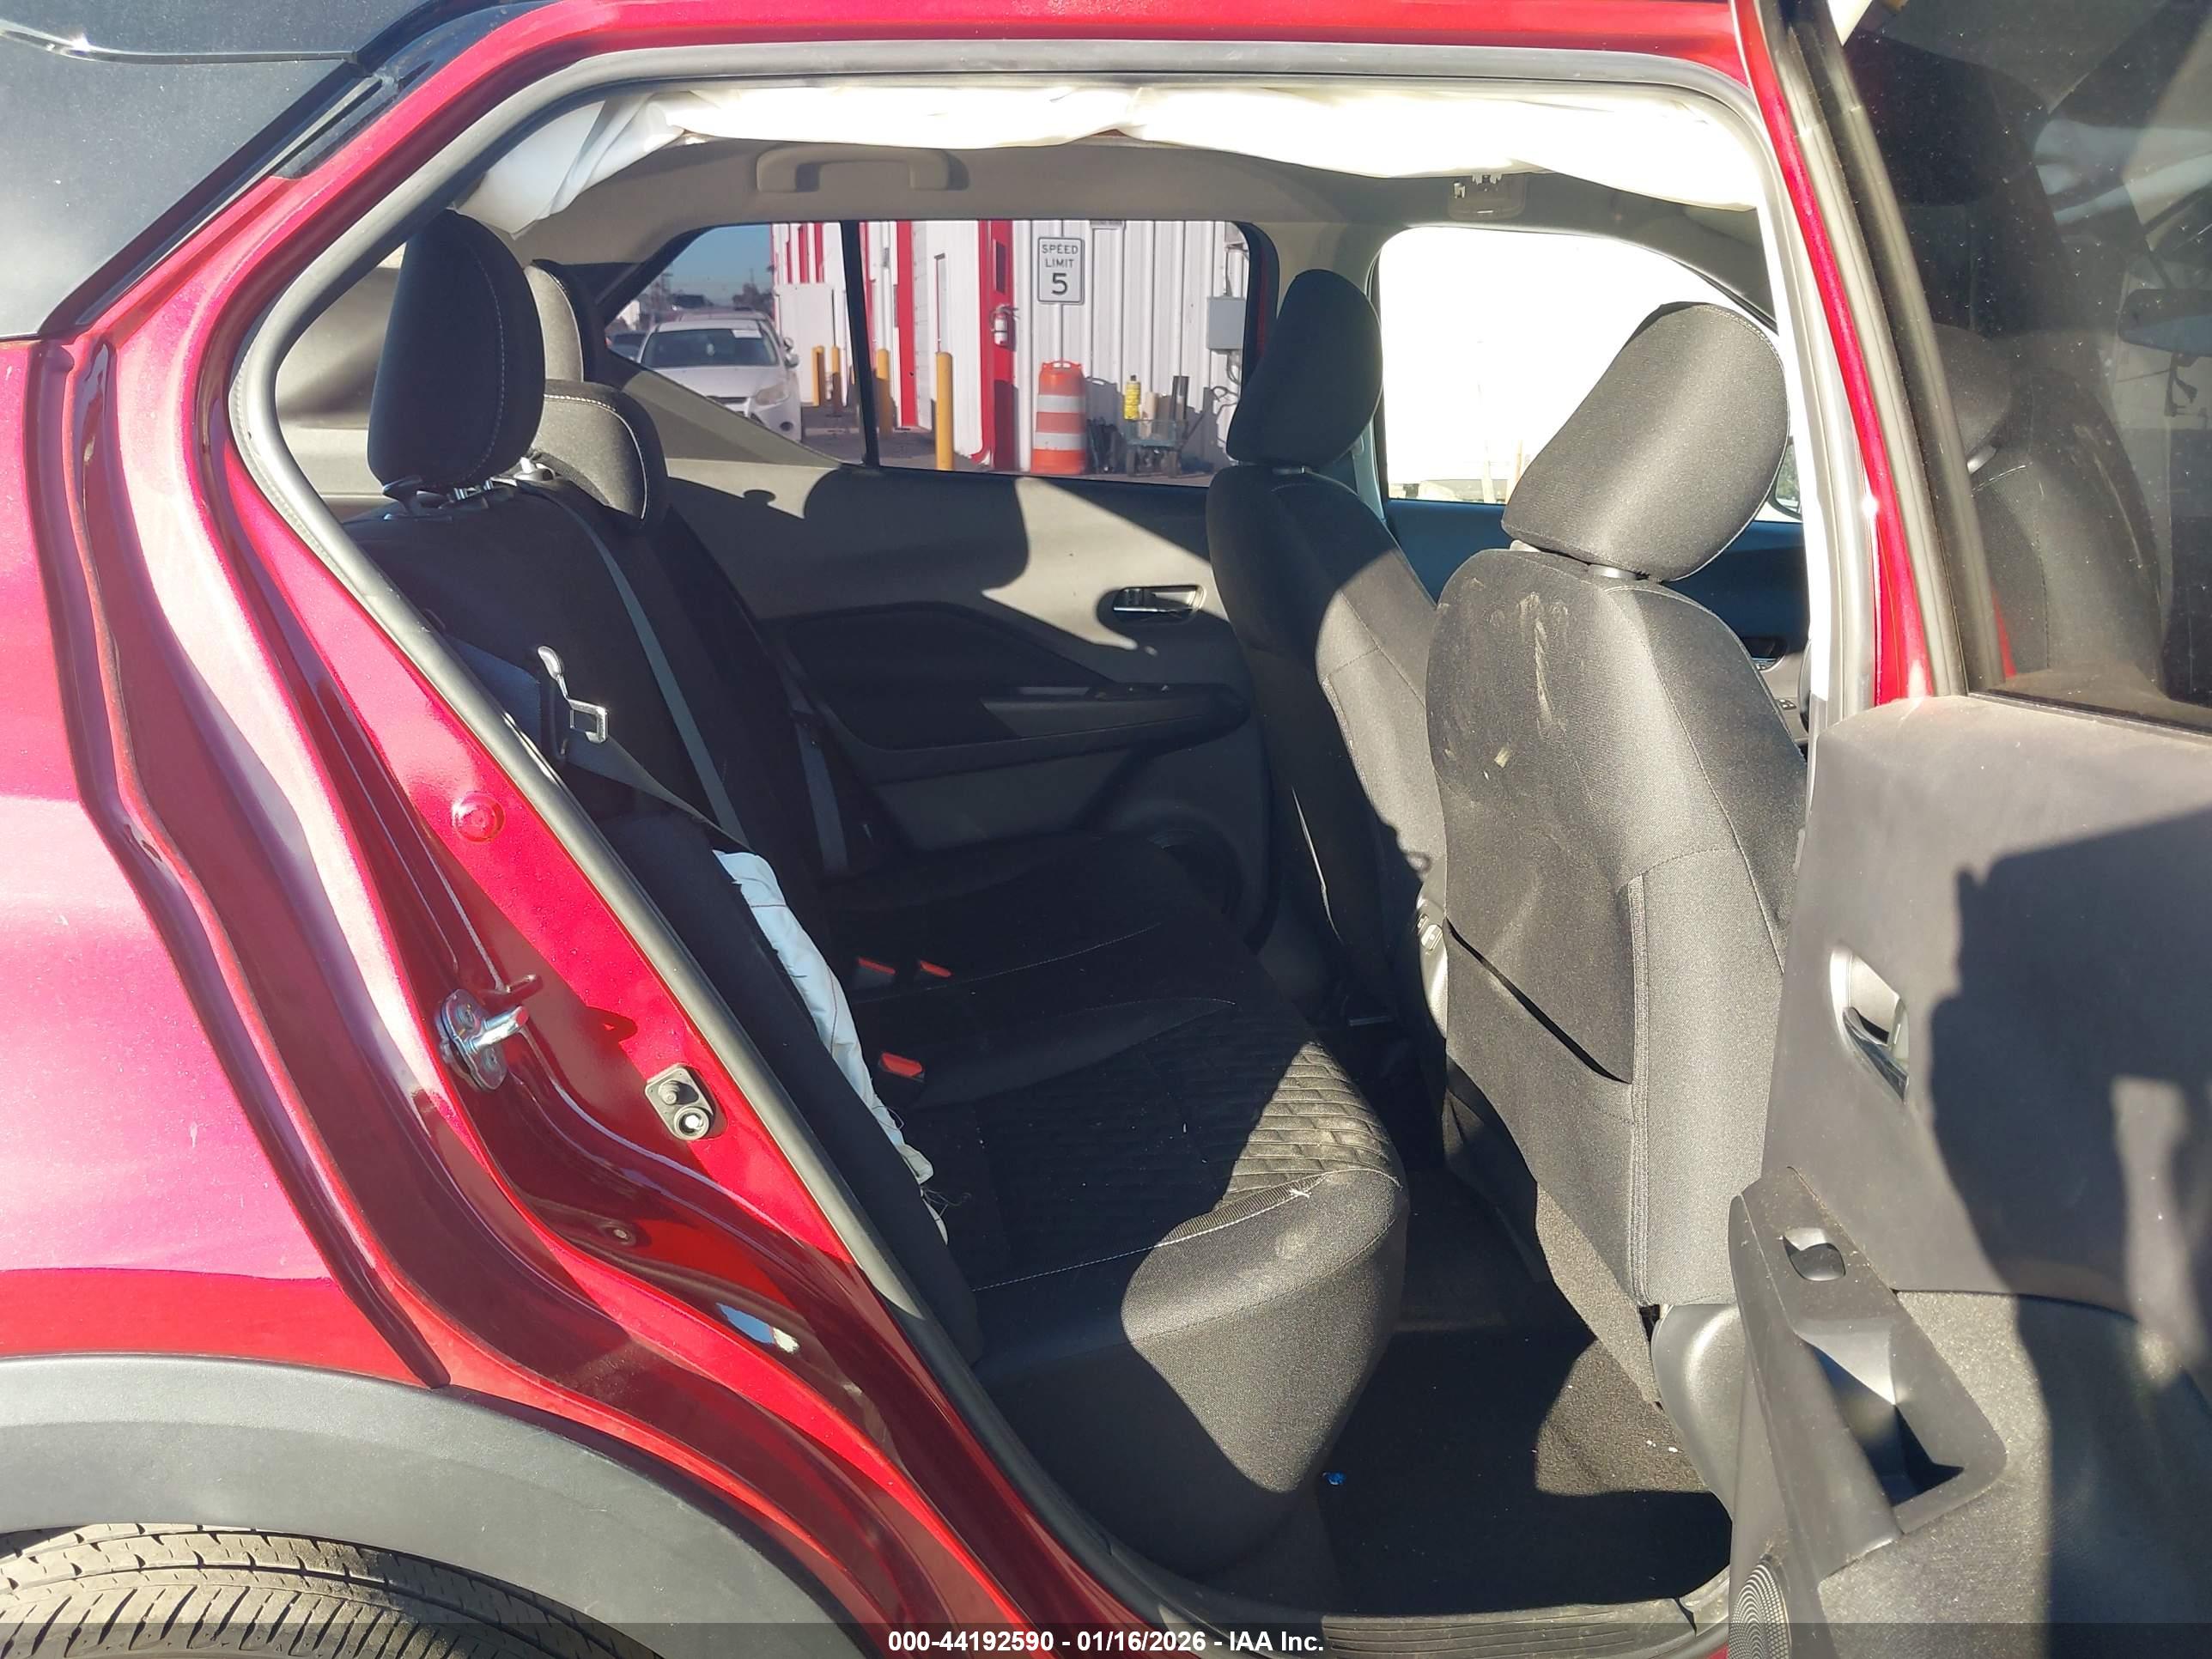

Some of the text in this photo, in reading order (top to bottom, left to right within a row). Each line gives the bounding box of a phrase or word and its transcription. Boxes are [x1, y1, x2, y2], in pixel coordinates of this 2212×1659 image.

[1042, 244, 1079, 255] SPEED
[1045, 258, 1074, 269] LIMIT
[1052, 273, 1068, 295] 5
